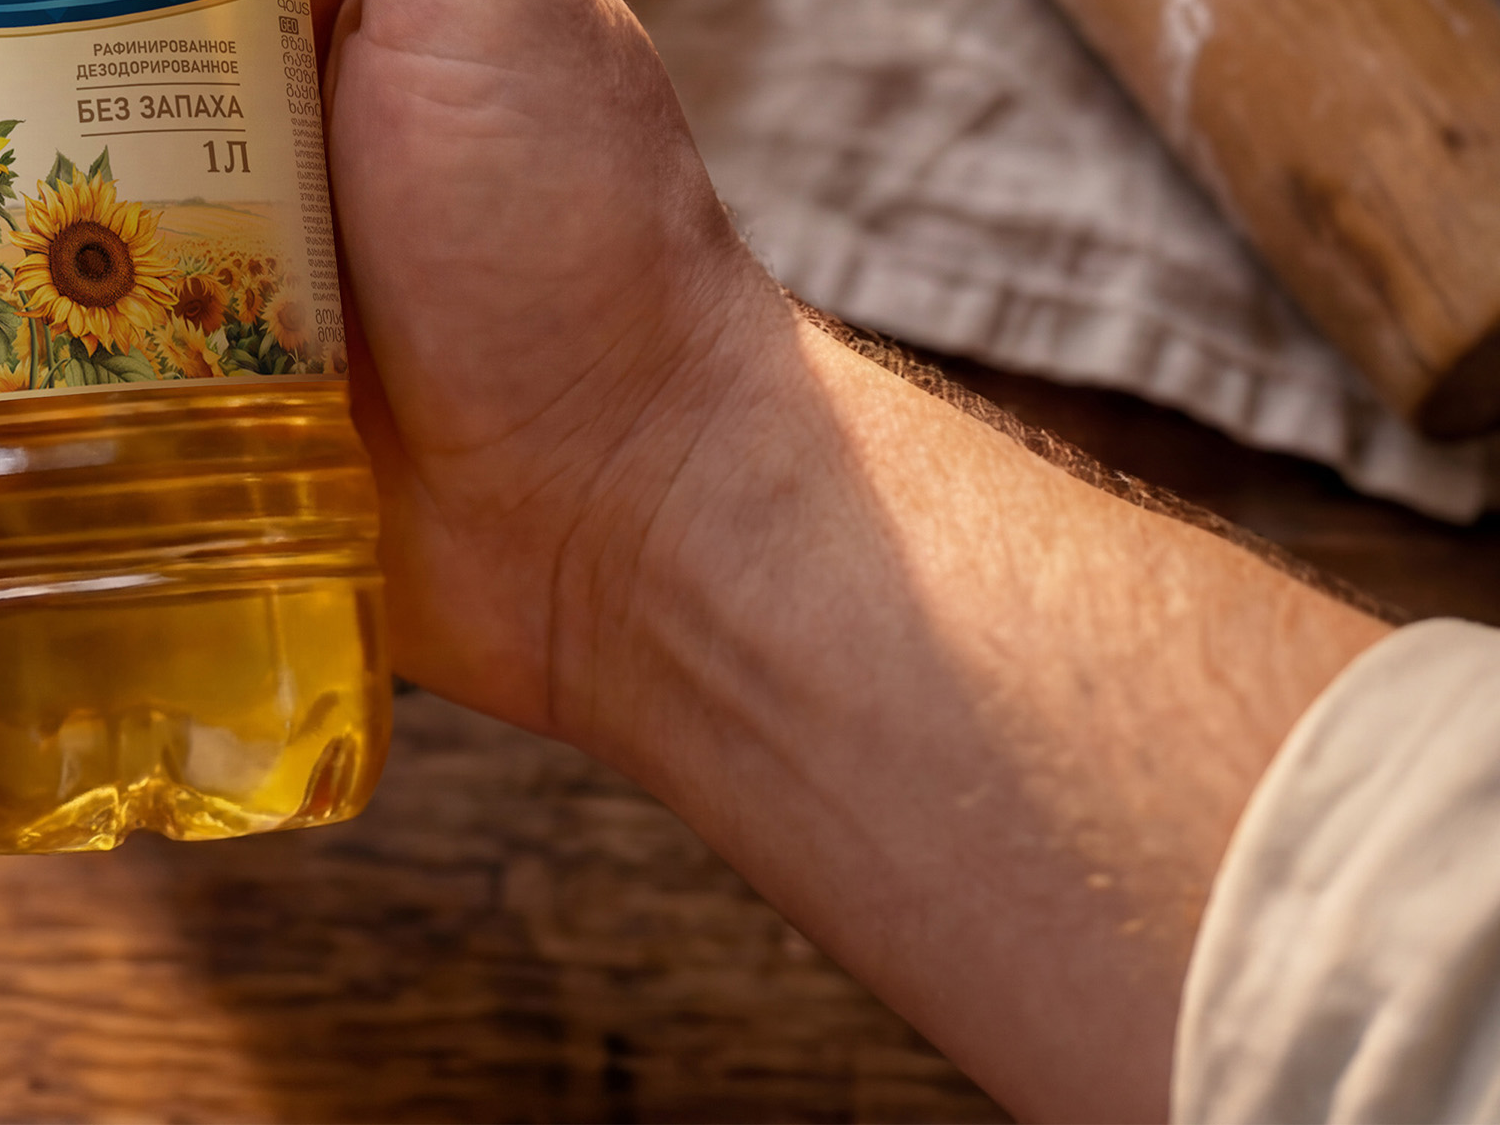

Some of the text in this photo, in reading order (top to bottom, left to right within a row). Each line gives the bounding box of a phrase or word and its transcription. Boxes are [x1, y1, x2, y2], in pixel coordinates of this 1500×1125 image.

[280, 17, 299, 34] GEO
[93, 40, 237, 56] РАФИНИРОВАННОЕ
[76, 59, 239, 81] ДЕЗОДОРИРОВАННОЕ
[77, 94, 245, 123] БЕЗ ЗАПАХА
